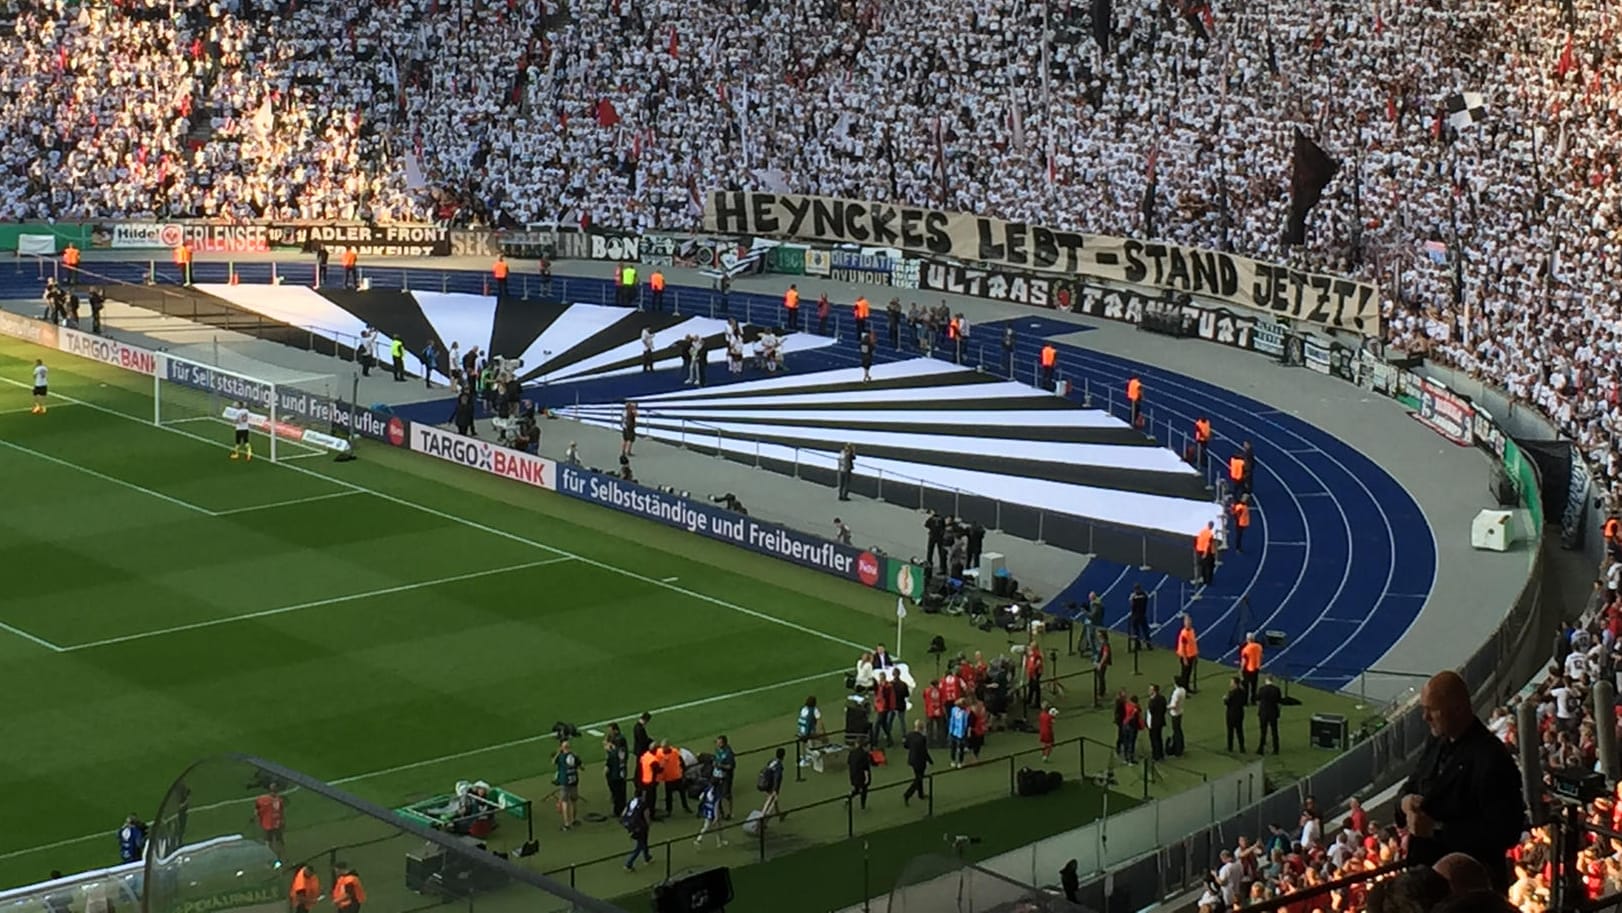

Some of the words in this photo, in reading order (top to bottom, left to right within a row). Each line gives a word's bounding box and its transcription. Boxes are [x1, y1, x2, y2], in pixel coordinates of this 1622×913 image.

[184, 225, 268, 250] ERLENSEE
[310, 227, 372, 241] ADLER
[386, 227, 448, 241] FRONT
[715, 191, 952, 253] HEYNCKES
[977, 218, 1083, 273] LEBT
[1252, 263, 1374, 330] JETZT!
[831, 269, 890, 286] OVUNQUE
[927, 263, 1050, 306] ULTRAS
[172, 359, 191, 381] für
[281, 394, 306, 415] und
[562, 468, 586, 491] für
[591, 477, 708, 531] Selbstständige
[712, 516, 745, 541] und
[749, 525, 853, 573] Freiberufler
